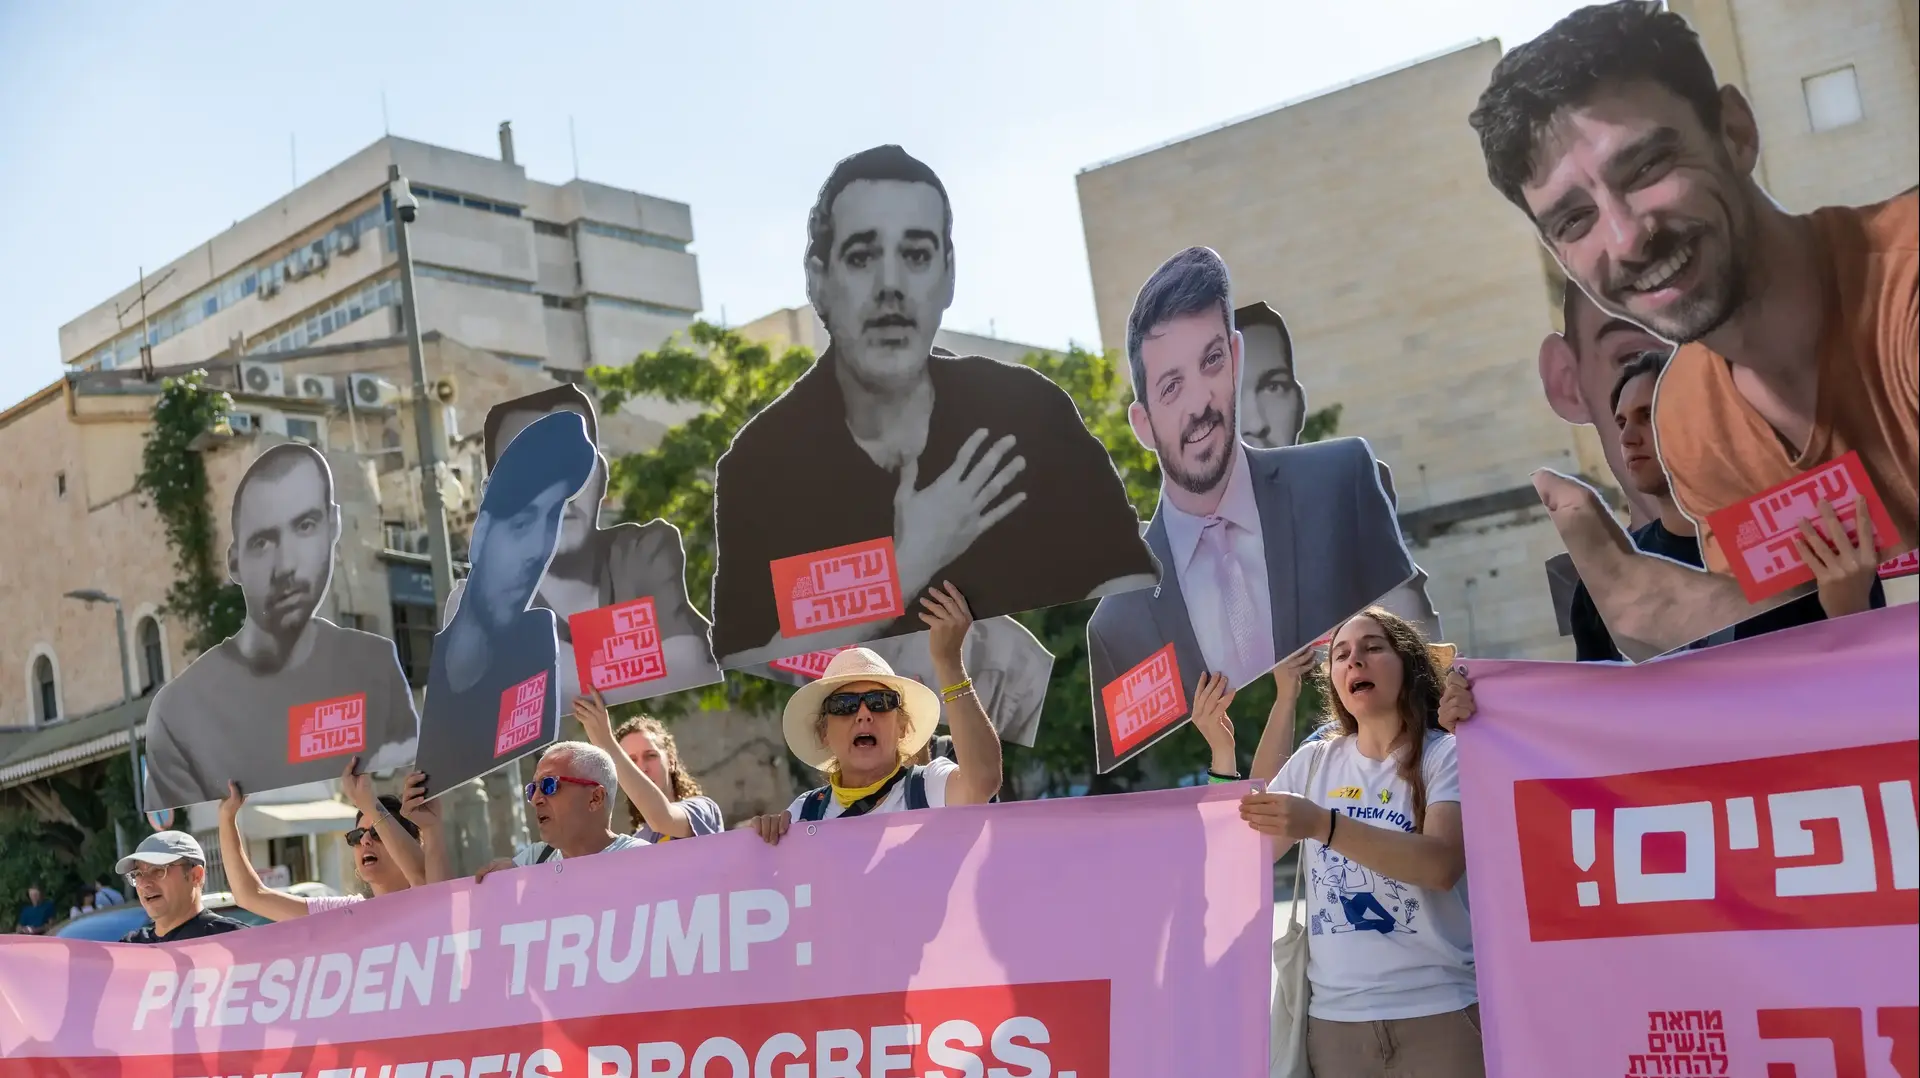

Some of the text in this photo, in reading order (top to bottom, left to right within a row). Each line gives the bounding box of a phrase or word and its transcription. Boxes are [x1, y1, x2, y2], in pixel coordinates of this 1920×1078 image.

[1758, 469, 1849, 532] עדיין
[815, 551, 883, 591] עדיין
[618, 607, 651, 628] בר
[805, 586, 892, 624] בעזה.
[606, 629, 654, 659] עדיין
[601, 655, 660, 684] בעזה.
[1125, 656, 1167, 701] עדיין
[518, 676, 545, 704] אלון
[317, 700, 361, 729] עדיין
[511, 698, 541, 728] עדיין
[1124, 686, 1175, 734] בעזה.
[306, 726, 361, 753] בעזה.
[502, 719, 538, 750] בעזה.
[1346, 806, 1418, 834] THEM HOM
[131, 884, 812, 1031] PRESIDENT TRUMP:
[1648, 1009, 1724, 1031] מחאת
[1647, 1032, 1727, 1053] הנשים
[1628, 1053, 1729, 1074] להחזרת
